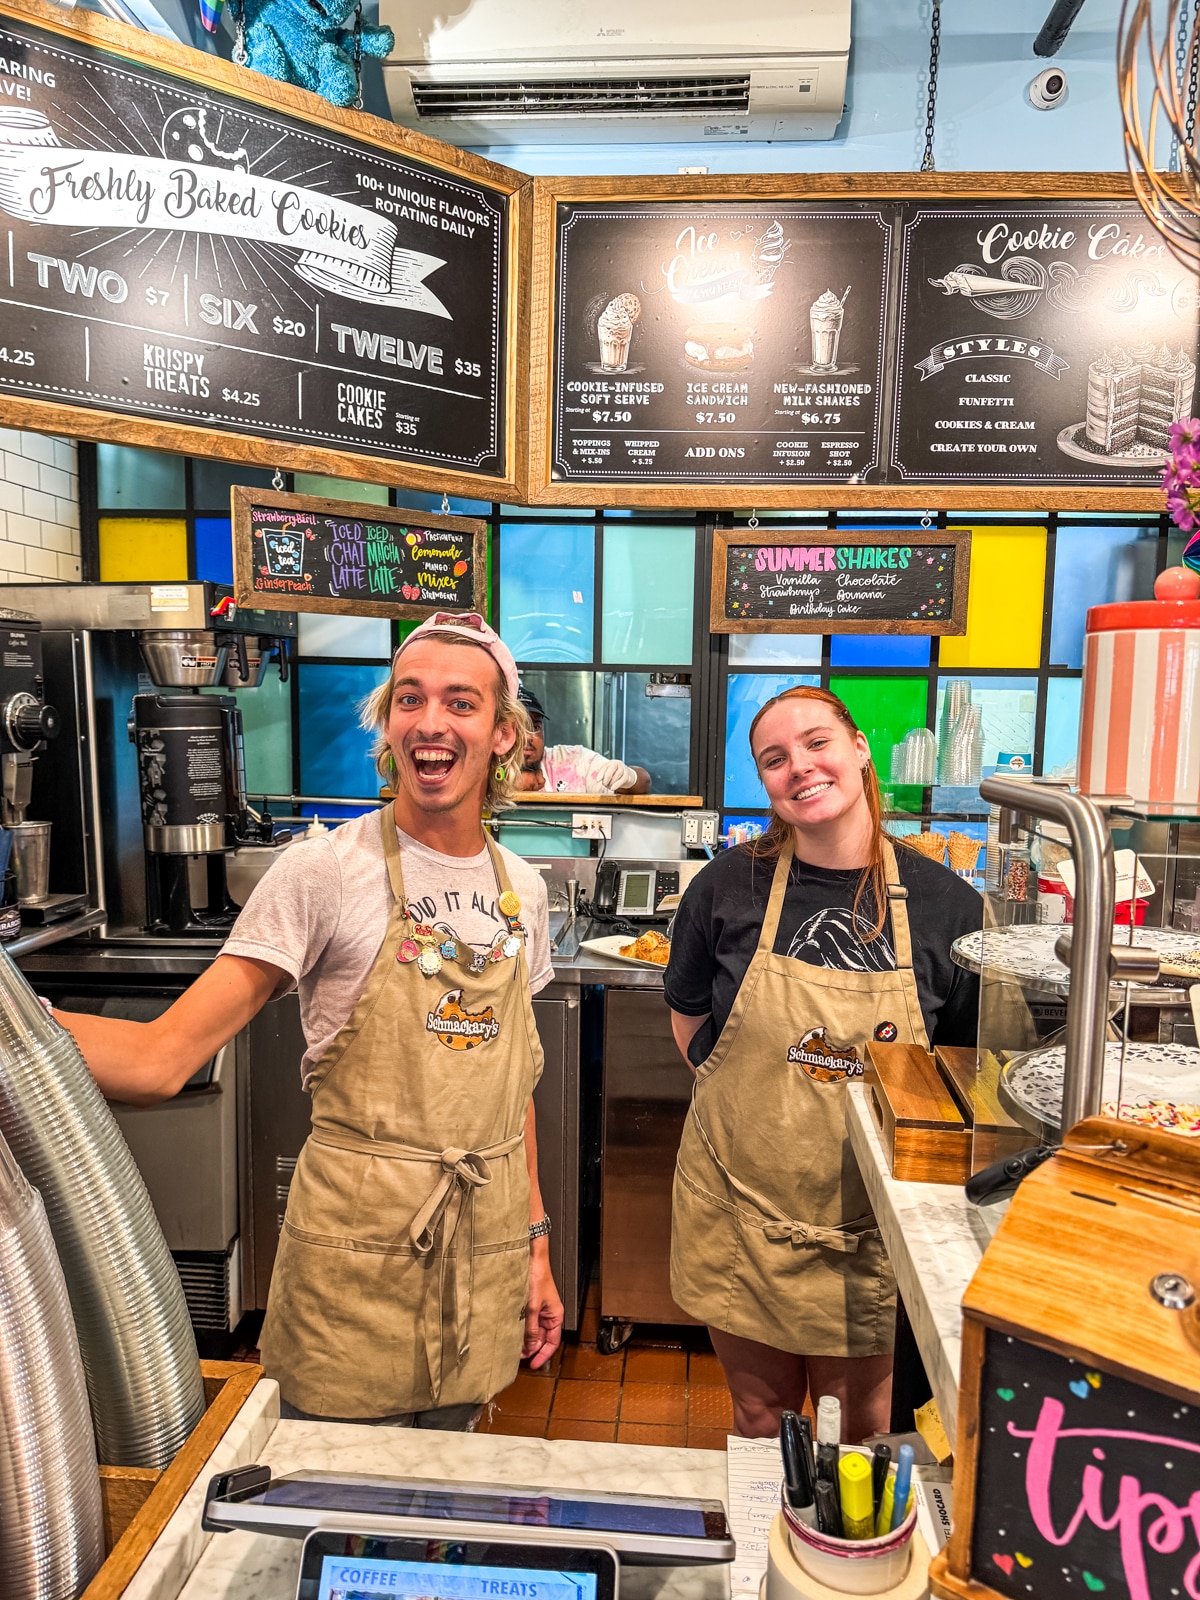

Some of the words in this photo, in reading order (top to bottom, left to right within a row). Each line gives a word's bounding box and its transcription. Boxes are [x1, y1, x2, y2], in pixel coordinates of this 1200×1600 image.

[0, 79, 31, 102] VE!
[29, 158, 156, 224] Freshly
[164, 168, 262, 219] Baked
[272, 190, 371, 249] Cookies
[355, 173, 384, 191] 100+
[388, 183, 436, 210] UNIQUE
[439, 200, 490, 227] FLAVORS
[376, 197, 438, 227] ROTATING
[441, 219, 476, 239] DAILY
[676, 226, 720, 259] Ice
[976, 223, 1077, 264] Cookie
[1088, 223, 1166, 260] Cakes
[27, 251, 129, 304] TWO
[145, 286, 170, 307] $7
[199, 293, 260, 335] SIX
[272, 316, 306, 338] $20
[330, 323, 444, 375] TWELVE
[454, 358, 482, 378] $35
[943, 338, 1043, 360] STYLES
[143, 343, 204, 375] KRISPY
[143, 366, 210, 398] TREATS
[222, 387, 260, 407] $4.25
[964, 374, 1011, 383] CLASSIC
[566, 382, 664, 393] COOKIE-INFUSED
[686, 383, 708, 393] ICE
[711, 383, 748, 393] CREAM
[773, 383, 871, 394] NEW-FASHIONED
[337, 382, 386, 411] COOKIE
[580, 394, 611, 405] SOFT
[614, 394, 650, 405] SERVE
[686, 395, 748, 405] SANDWICH
[783, 396, 812, 406] MILK
[815, 396, 860, 406] SHAKES
[958, 397, 1014, 407] FUNFETTI
[337, 404, 383, 430] CAKES
[592, 410, 632, 423] $7.50
[695, 411, 736, 424] $7.50
[801, 412, 841, 425] $6.75
[934, 420, 982, 430] COOKIES
[983, 421, 993, 430] &
[994, 421, 1036, 430] CREAM
[396, 421, 417, 435] $35
[572, 439, 611, 447] TOPPINGS
[821, 441, 859, 449] ESPRESSO
[930, 443, 975, 453] CREATE
[976, 443, 1007, 453] YOUR
[1009, 444, 1037, 453] OWN
[684, 447, 715, 458] ADD
[718, 447, 745, 458] ONS
[833, 459, 852, 467] $2.50
[330, 523, 362, 542] ICED
[365, 525, 389, 540] ICED
[274, 541, 295, 553] iced
[330, 541, 367, 567] CHAI
[367, 540, 401, 568] MATCHA
[411, 544, 463, 561] Lemonade
[277, 555, 296, 566] tea
[425, 562, 448, 572] MANGO
[754, 547, 837, 572] SUMMER
[836, 547, 912, 570] SHAKES
[331, 564, 367, 590] LATTE
[368, 565, 399, 595] LATTE
[417, 572, 459, 590] Mixes
[775, 573, 822, 586] Vanilla
[835, 572, 902, 587] Chocolate
[759, 585, 820, 603] Strawberry
[836, 589, 887, 600] Banana
[789, 602, 836, 618] Birthday
[837, 604, 862, 614] Cake
[444, 891, 460, 912] IT
[472, 891, 499, 922] ALL
[1044, 1008, 1067, 1017] BEVE
[427, 1013, 499, 1039] Schmackary's
[788, 1047, 864, 1075] Schmackary's
[933, 1488, 951, 1526] SHOCARD
[340, 1569, 398, 1586] COFFEE
[481, 1580, 537, 1597] TREATS
